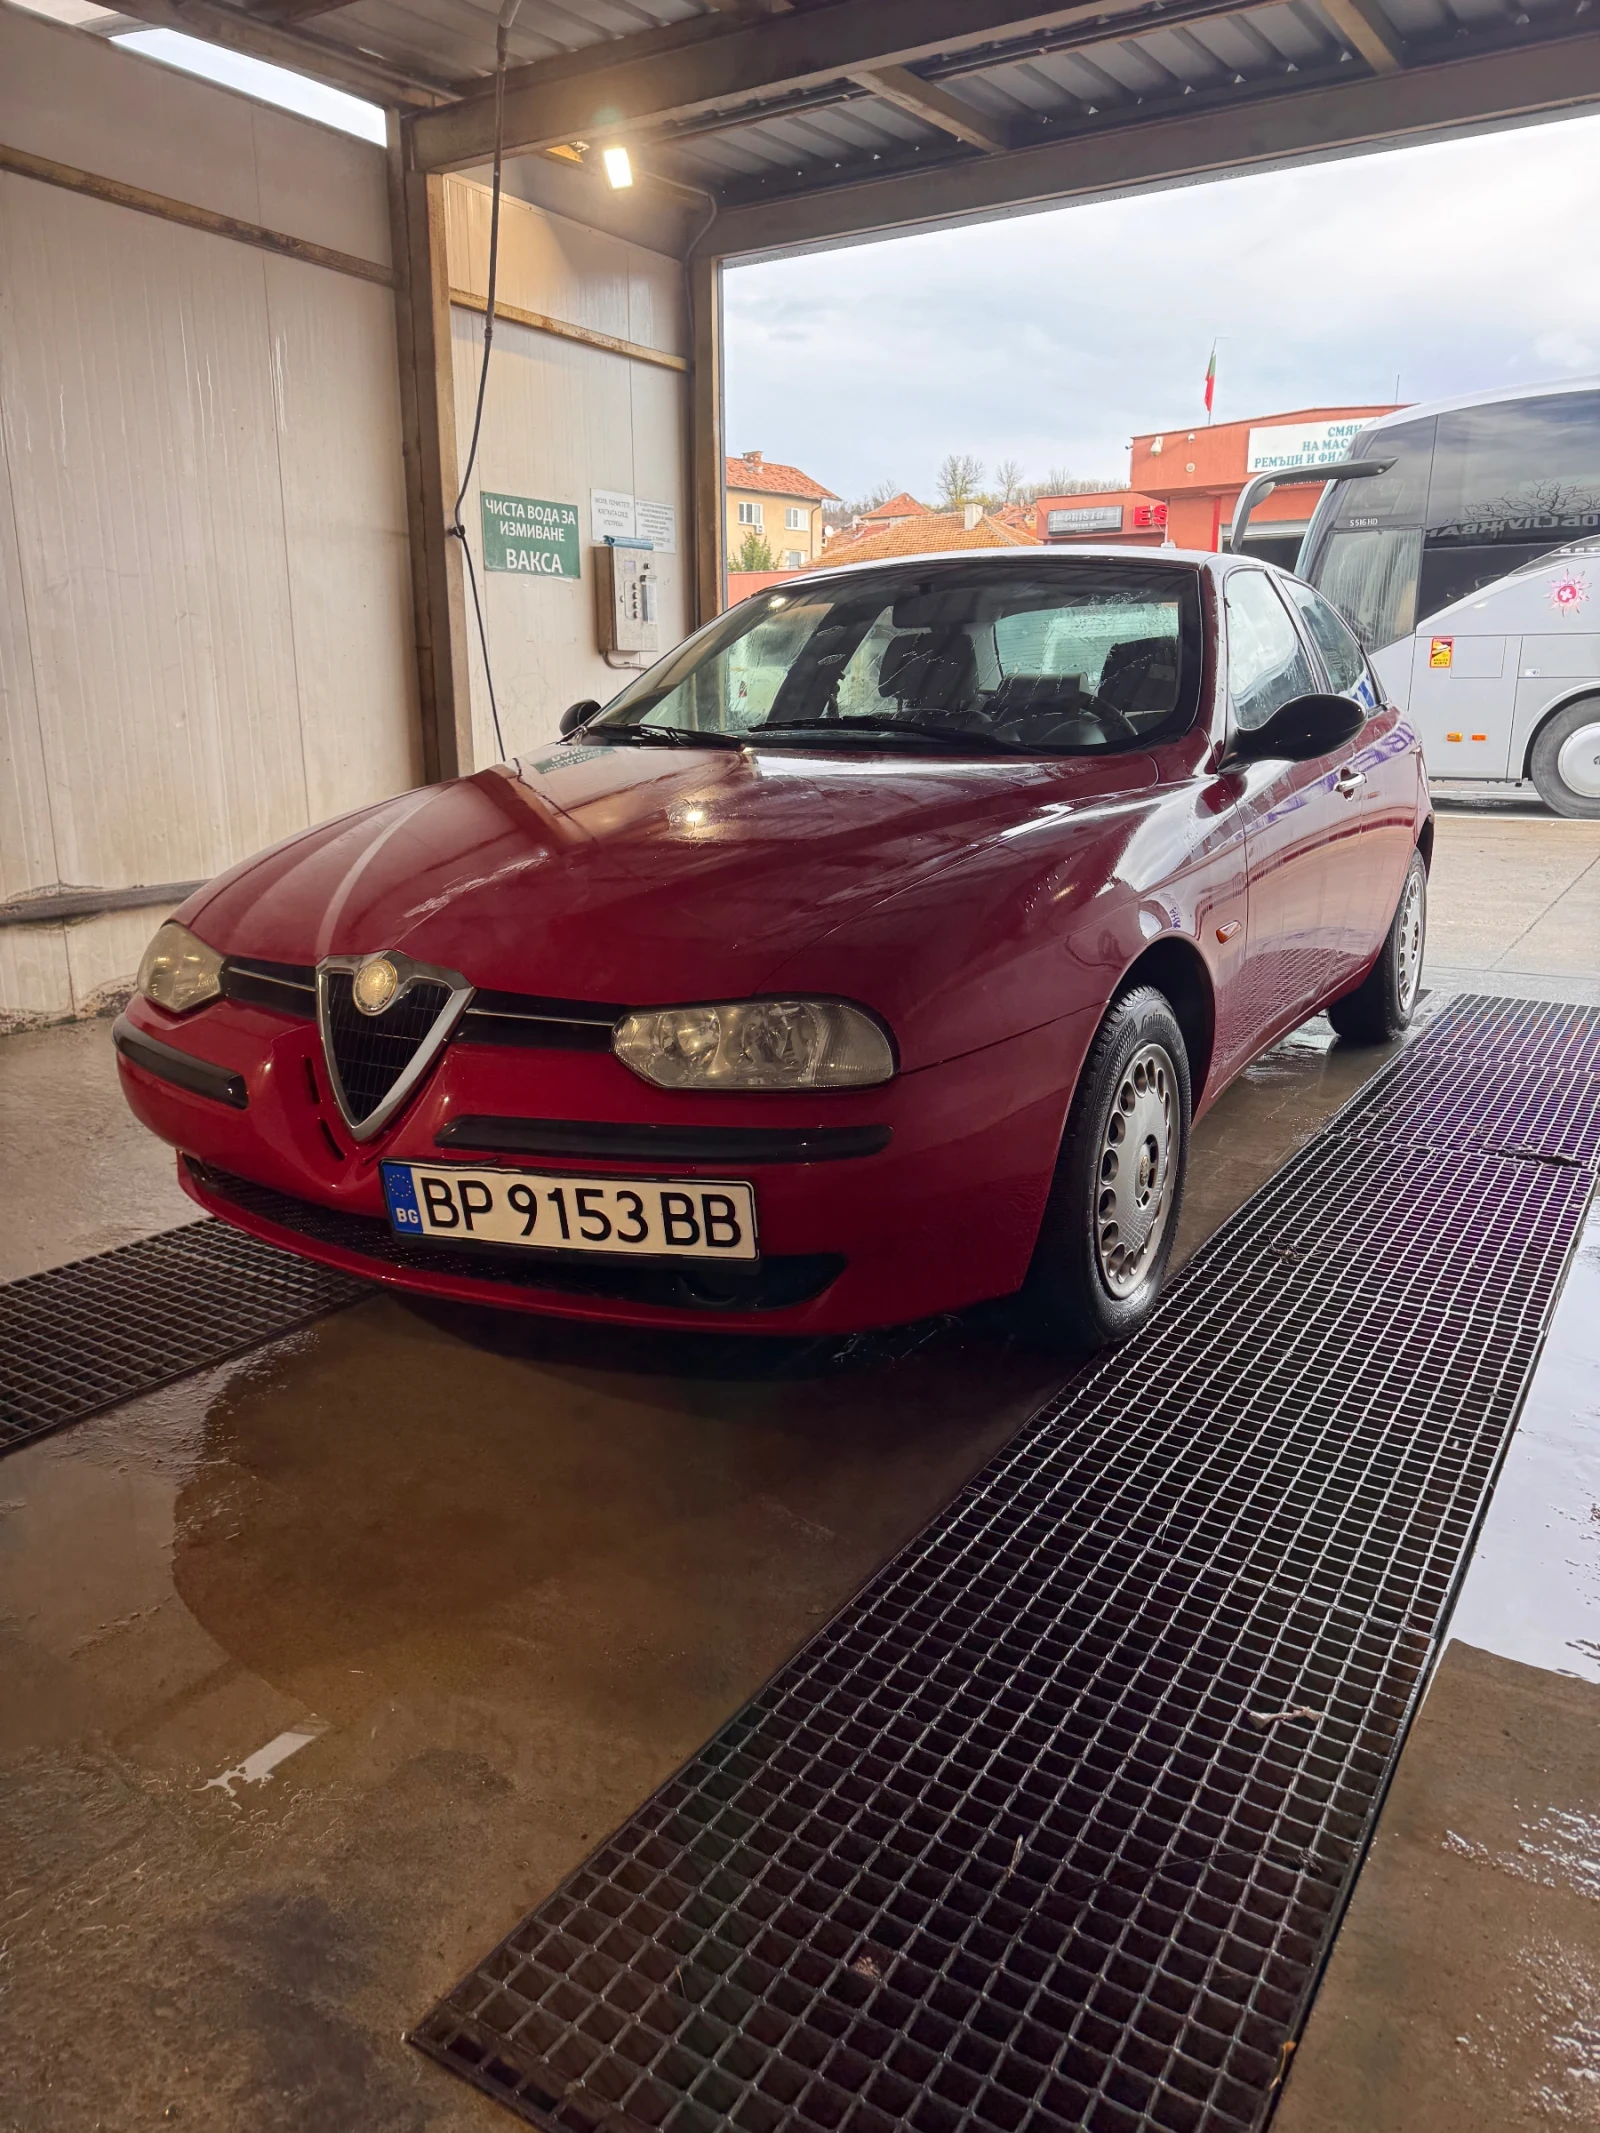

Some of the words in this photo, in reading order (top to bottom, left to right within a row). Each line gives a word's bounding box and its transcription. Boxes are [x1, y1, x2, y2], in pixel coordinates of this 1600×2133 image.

[1302, 441, 1319, 452] НА
[1321, 439, 1349, 450] МАС
[1254, 454, 1303, 468] РЕМЪЦИ
[1306, 453, 1315, 464] И
[485, 498, 525, 518] ЧИСТА
[527, 505, 560, 525] ВОДА
[561, 509, 576, 525] ЗА
[499, 520, 565, 542] ИЗМИВАНЕ
[505, 547, 563, 574] ВАКСА
[396, 1207, 419, 1225] BG
[420, 1176, 493, 1231] BP
[507, 1183, 649, 1243] 9153
[659, 1191, 742, 1248] BB
